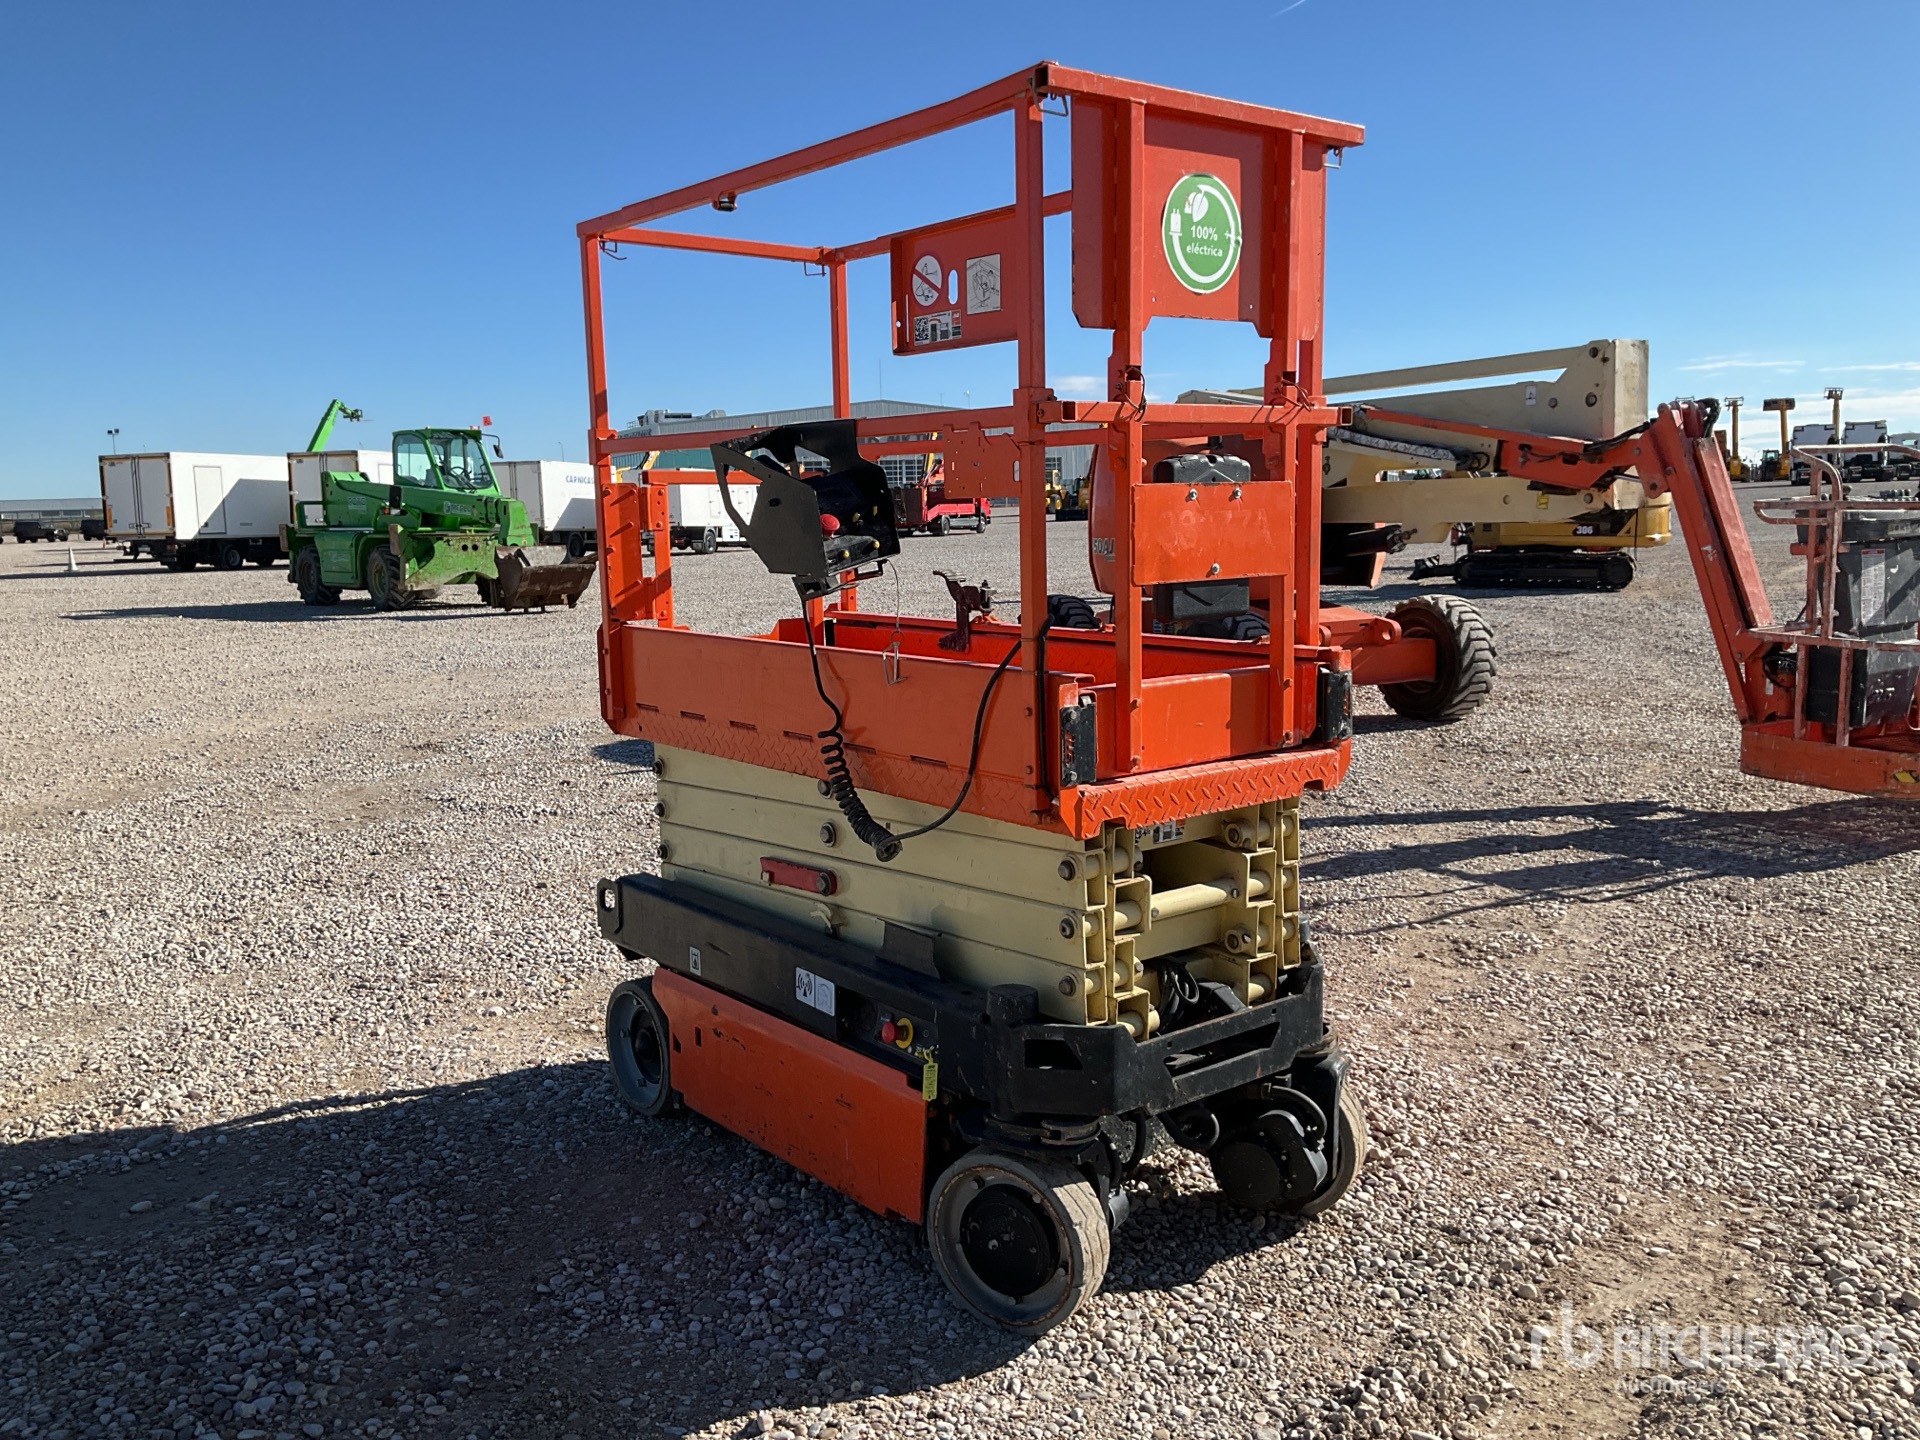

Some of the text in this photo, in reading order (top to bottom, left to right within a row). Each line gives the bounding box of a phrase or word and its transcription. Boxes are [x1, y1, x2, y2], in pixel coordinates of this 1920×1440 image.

[1190, 225, 1218, 241] 100%
[1186, 242, 1223, 257] eléctrica
[1576, 525, 1593, 535] 306
